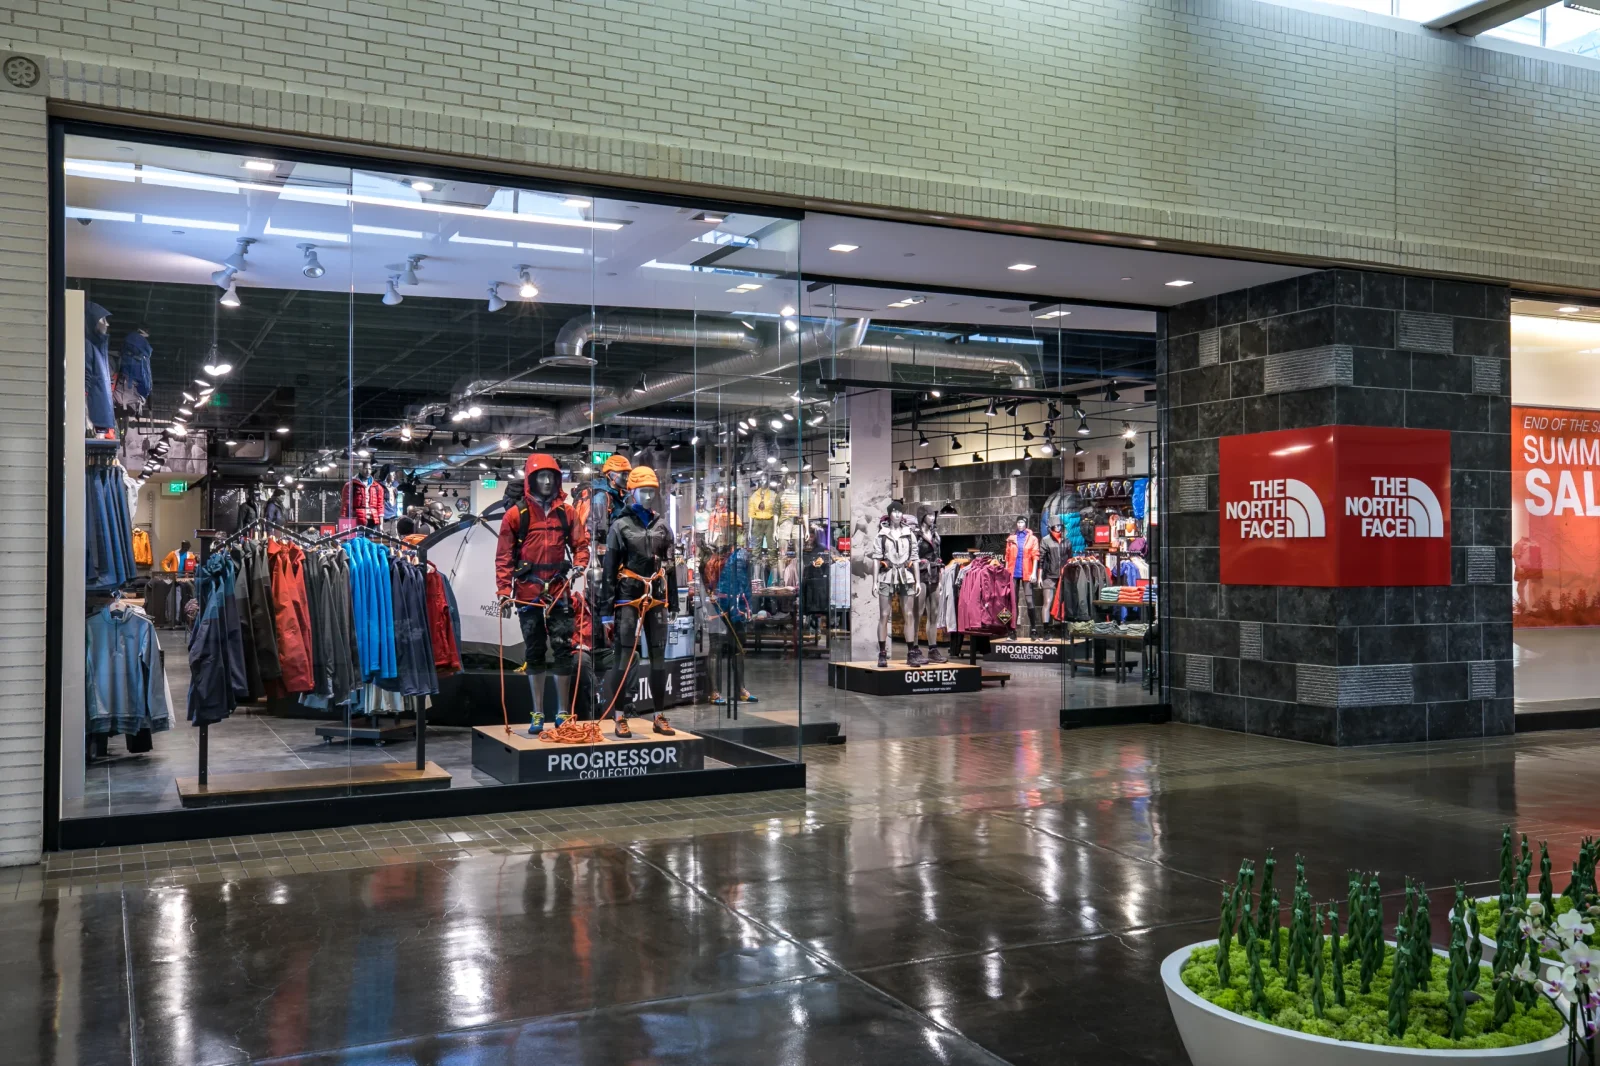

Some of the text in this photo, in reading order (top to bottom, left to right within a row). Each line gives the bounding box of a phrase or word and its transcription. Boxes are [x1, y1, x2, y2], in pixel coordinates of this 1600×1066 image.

[1524, 416, 1548, 430] END
[1551, 418, 1567, 431] OF
[1570, 419, 1590, 432] THE
[1523, 435, 1600, 466] SUMM
[1249, 479, 1285, 499] THE
[1371, 477, 1407, 496] THE
[1525, 467, 1600, 517] SAL
[1226, 500, 1285, 519] NORTH
[1345, 497, 1407, 517] NORTH
[1241, 520, 1285, 539] FACE
[1361, 518, 1407, 538] FACE
[995, 645, 1058, 655] PROGRESSOR
[548, 747, 677, 772] PROGRESSOR
[579, 766, 648, 780] COLLECTION
